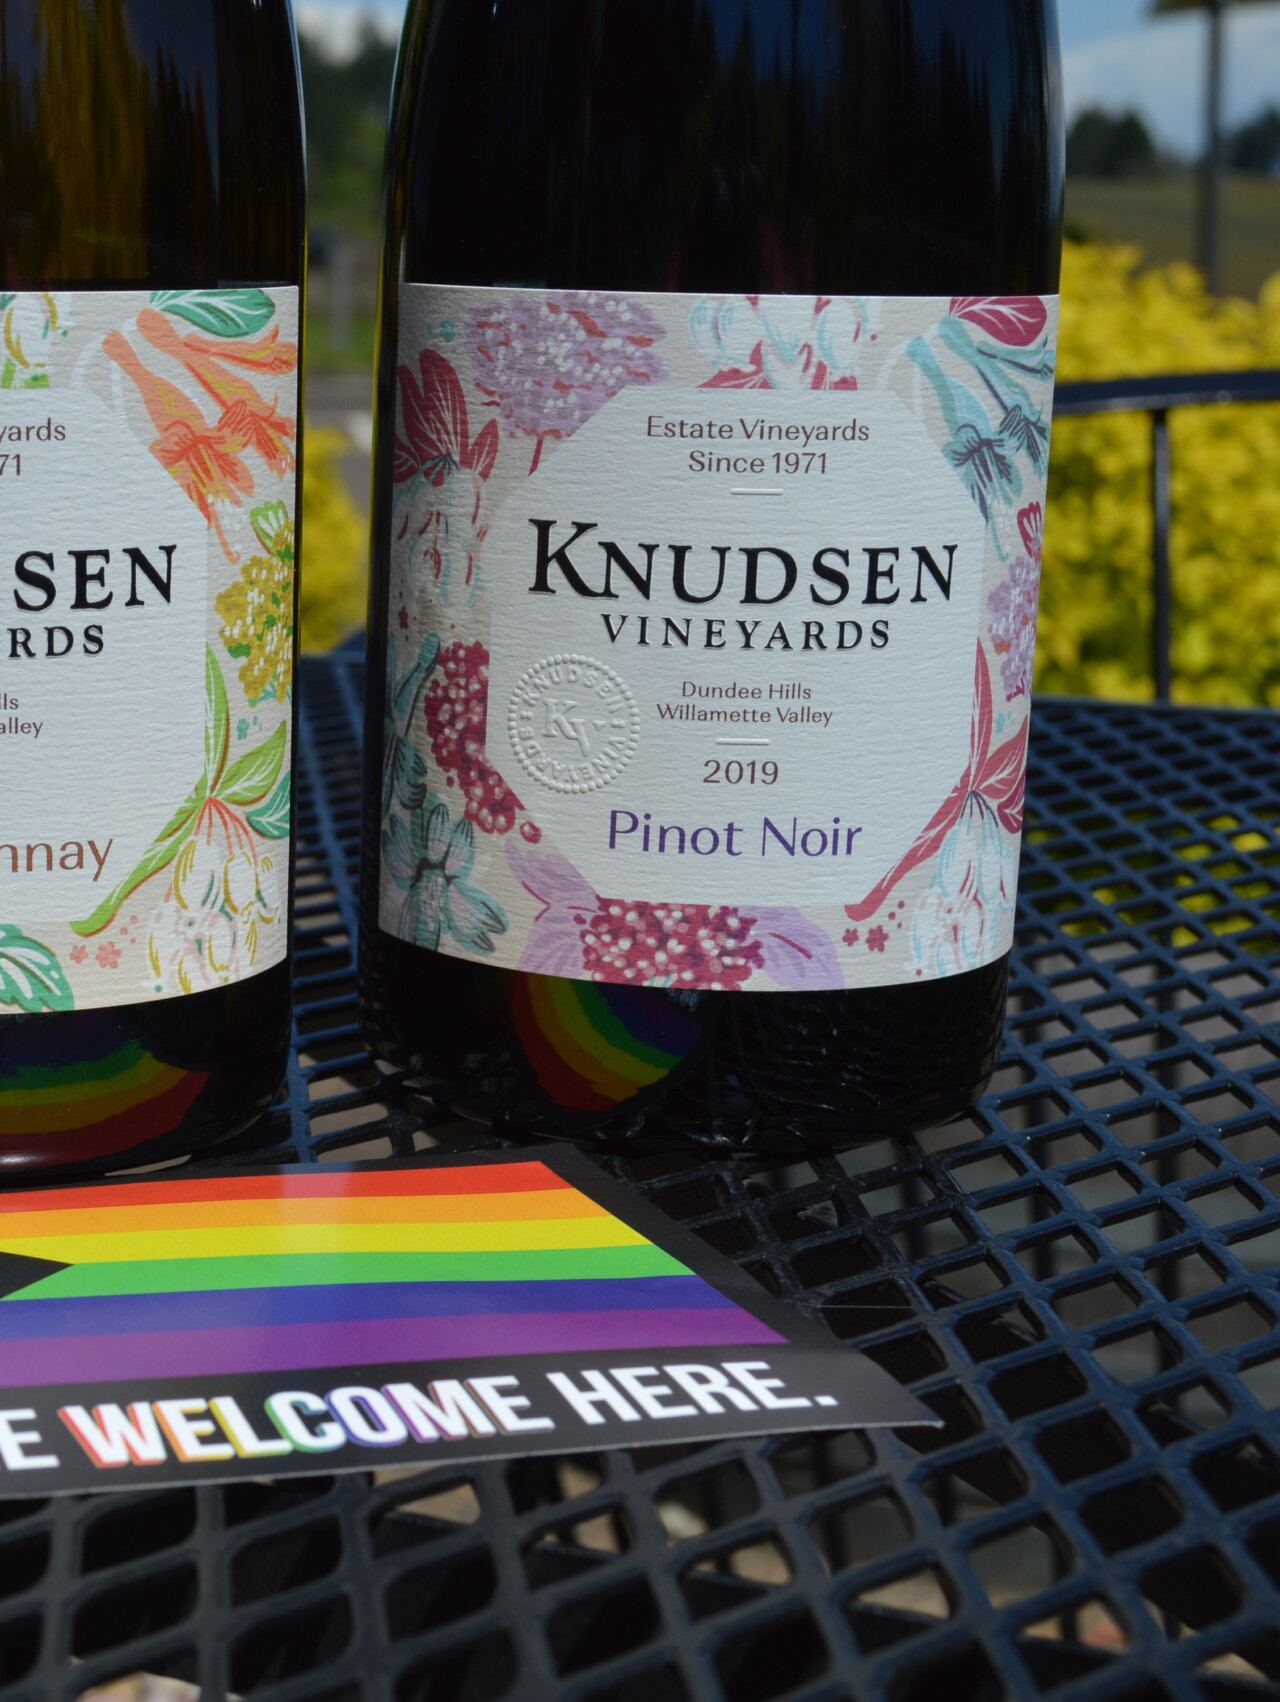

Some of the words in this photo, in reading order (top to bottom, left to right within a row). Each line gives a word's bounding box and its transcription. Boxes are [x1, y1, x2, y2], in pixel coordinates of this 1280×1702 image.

[646, 415, 734, 439] Estate
[740, 418, 870, 448] Vineyards
[688, 449, 765, 473] Since
[772, 452, 829, 474] 1971
[528, 518, 959, 606] KNUDSEN
[600, 613, 890, 651] VINEYARDS
[522, 665, 625, 714] KNUDSEN
[681, 681, 763, 700] Dundee
[768, 682, 812, 700] Hills
[656, 703, 772, 723] Willamette
[775, 706, 834, 728] Valley
[703, 759, 780, 787] 2019
[608, 809, 743, 857] Pinot
[761, 816, 863, 858] Noir
[58, 1375, 556, 1468] WELCOME
[546, 1361, 839, 1425] HERE.
